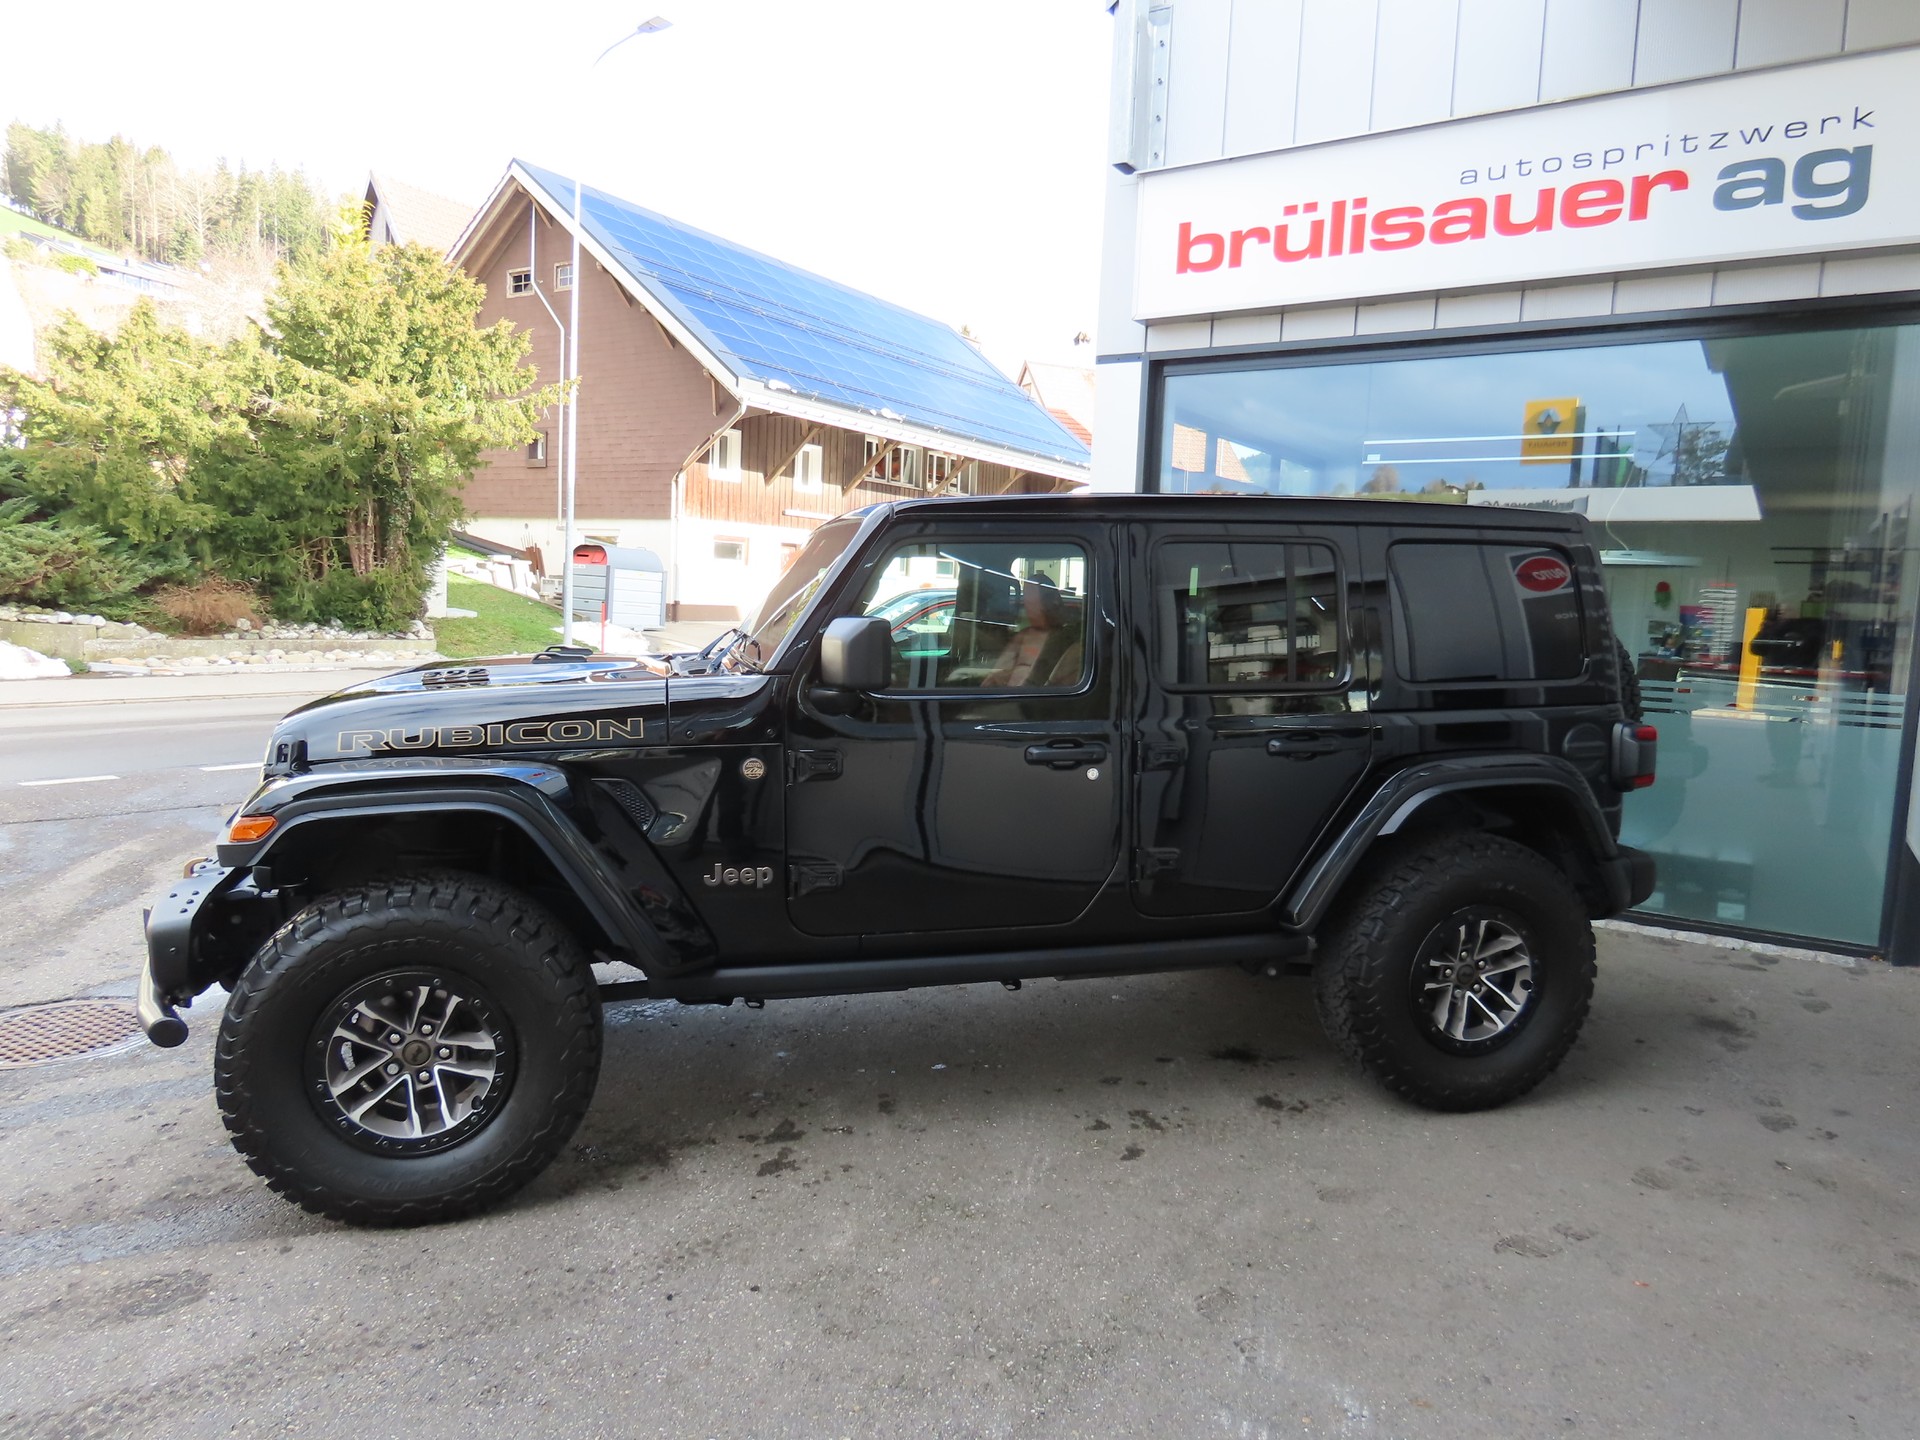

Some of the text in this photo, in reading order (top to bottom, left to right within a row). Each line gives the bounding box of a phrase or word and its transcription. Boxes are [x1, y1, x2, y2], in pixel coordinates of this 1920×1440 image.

[1460, 106, 1876, 185] autospritzwerk
[1175, 144, 1873, 273] brülisauer ag
[337, 717, 644, 752] RUBICON
[703, 863, 774, 889] Jeep
